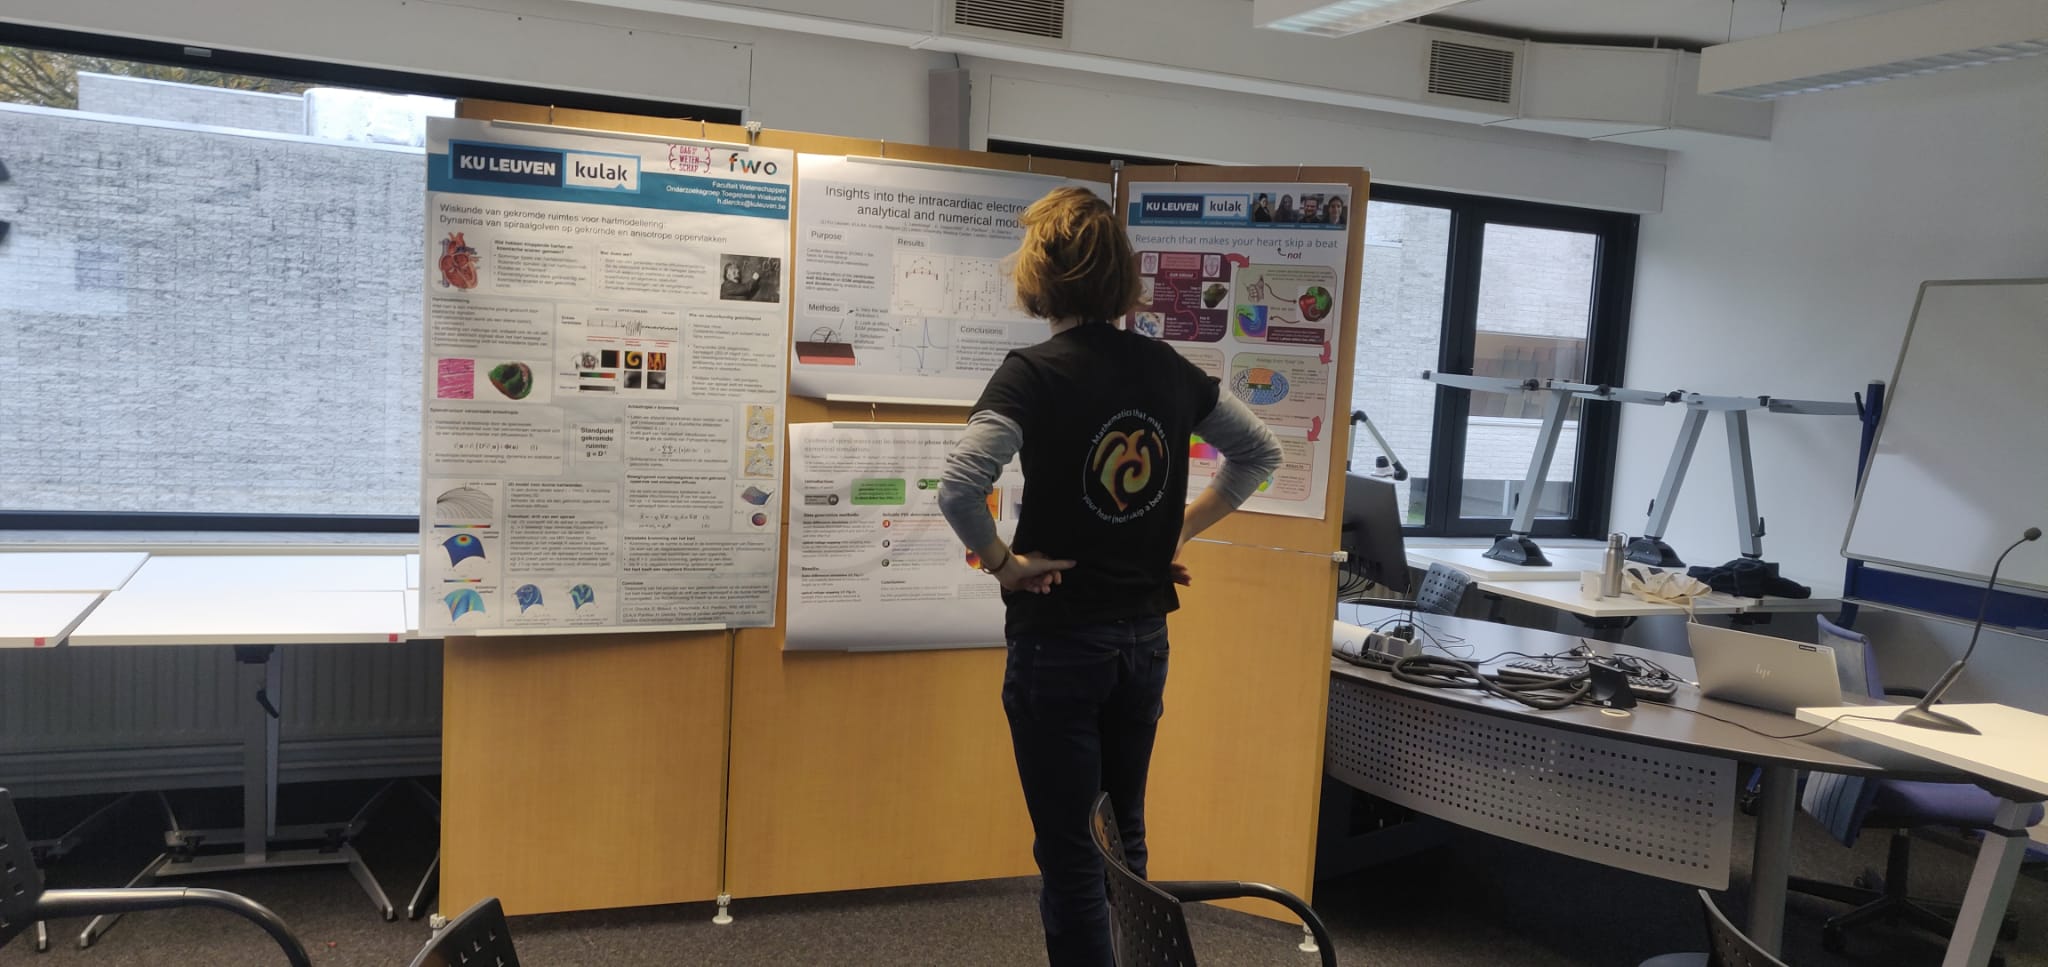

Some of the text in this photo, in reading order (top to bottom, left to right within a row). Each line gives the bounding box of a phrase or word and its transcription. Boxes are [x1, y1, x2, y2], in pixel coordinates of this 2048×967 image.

[459, 154, 557, 177] KU LEUVEN
[575, 160, 628, 182] kulak
[728, 152, 778, 176] fwo
[666, 185, 720, 197] Onderzoeksgroep
[757, 193, 787, 202] Wiskunde
[739, 183, 787, 194] Wetenschappen
[825, 185, 870, 201] Insights
[873, 190, 895, 204] into
[897, 191, 915, 205] the
[918, 193, 984, 211] intracardiac
[440, 204, 483, 215] Wiskunde
[503, 210, 546, 219] gekromde
[547, 213, 579, 222] ruimtes
[581, 215, 599, 223] voor
[1145, 201, 1200, 212] KU LEUVEN
[1209, 200, 1242, 213] kulak
[857, 204, 911, 220] analytical
[914, 209, 935, 222] and
[938, 211, 993, 227] numerical
[440, 214, 484, 226] Dynamica
[486, 219, 501, 227] van
[504, 220, 560, 232] spiraalgolven
[562, 225, 573, 233] op
[574, 226, 616, 236] gekromde
[630, 230, 673, 241] anisotrope
[674, 233, 728, 244] oppervlakken
[811, 230, 843, 241] Purpose
[897, 237, 925, 248] Results
[1135, 234, 1176, 244] Research
[1178, 235, 1197, 245] that
[1199, 236, 1229, 246] makes
[1231, 238, 1254, 248] your
[1256, 238, 1282, 248] heart
[1285, 239, 1304, 250] skip
[1315, 239, 1338, 249] beat
[1287, 251, 1302, 260] not
[808, 302, 841, 314] Methods
[960, 325, 1004, 336] Conclusions
[1091, 408, 1166, 445] Mathematics that makes
